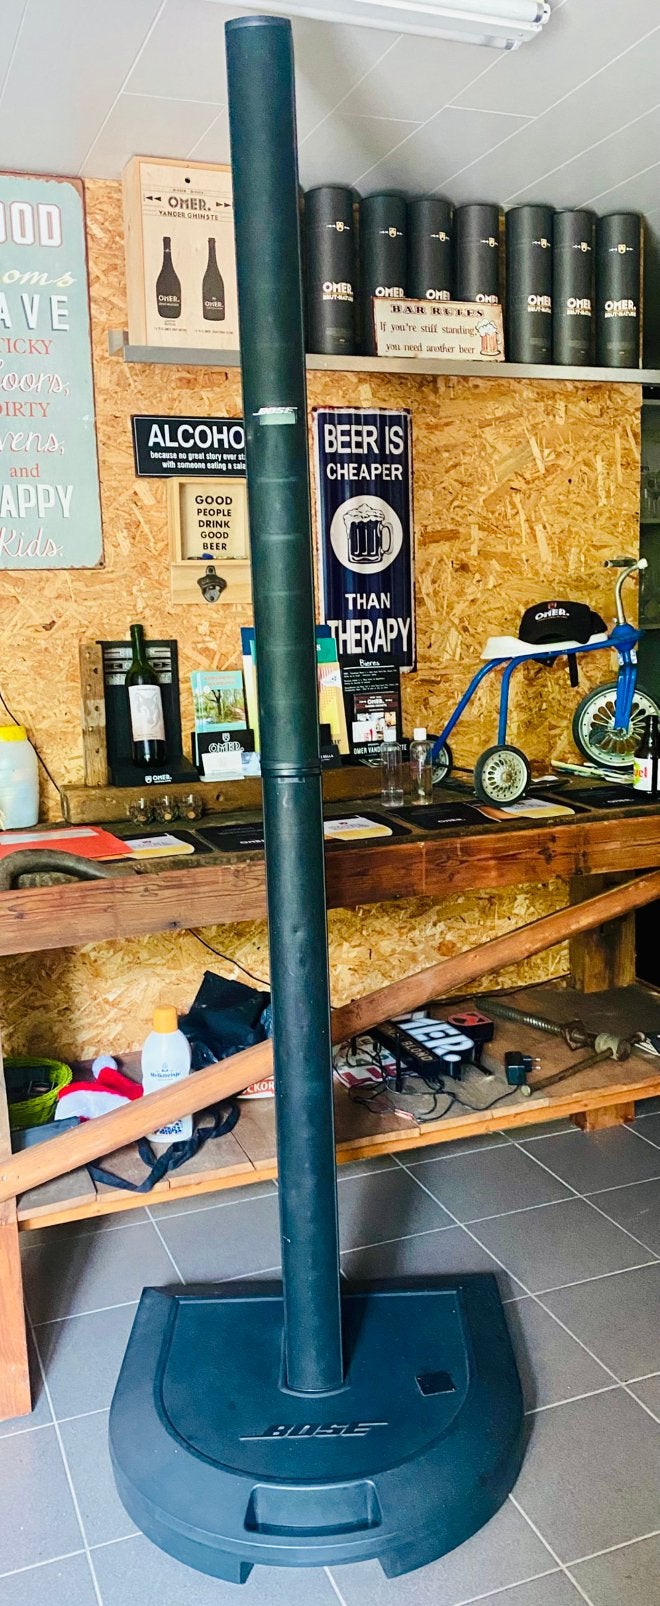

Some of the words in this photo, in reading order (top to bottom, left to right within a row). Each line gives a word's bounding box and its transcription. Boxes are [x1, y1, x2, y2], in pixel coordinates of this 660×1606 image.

[168, 196, 211, 211] OMER.
[159, 210, 186, 218] VANDER
[187, 212, 219, 220] GHINSTE
[0, 200, 62, 248] OD
[1, 269, 77, 288] oms
[426, 288, 451, 300] OME
[527, 294, 552, 306] OME
[566, 297, 591, 309] OME
[604, 299, 637, 312] OMER.
[0, 291, 70, 332] AVE
[390, 304, 427, 314] BAR
[431, 305, 485, 317] RULES
[380, 321, 387, 333] If
[391, 322, 417, 333] you're
[0, 337, 53, 354] ICKY
[386, 342, 400, 352] you
[404, 342, 422, 352] need
[426, 342, 456, 354] another
[460, 344, 476, 354] beer
[0, 360, 69, 397] oors,
[0, 401, 50, 417] IRTY
[252, 406, 298, 416] BOSE
[148, 423, 246, 450] ALCOHO
[324, 423, 379, 455] BEER
[385, 424, 404, 455] IS
[150, 450, 178, 459] because
[188, 452, 205, 461] great
[206, 453, 222, 462] story
[9, 463, 40, 478] and
[162, 460, 176, 468] with
[206, 462, 226, 471] eating
[233, 462, 246, 470] sala
[326, 462, 403, 481] CHEAPER
[0, 484, 73, 518] APPY
[195, 495, 233, 506] GOOD
[197, 508, 232, 517] PEOPLE
[198, 520, 230, 528] DRINK
[200, 531, 229, 539] GOOD
[202, 542, 228, 551] BEER
[345, 592, 391, 611] THAN
[534, 608, 570, 621] OMER.
[327, 617, 411, 655] THERAPY
[391, 1011, 475, 1063] MER.
[239, 1422, 389, 1441] BOSE
